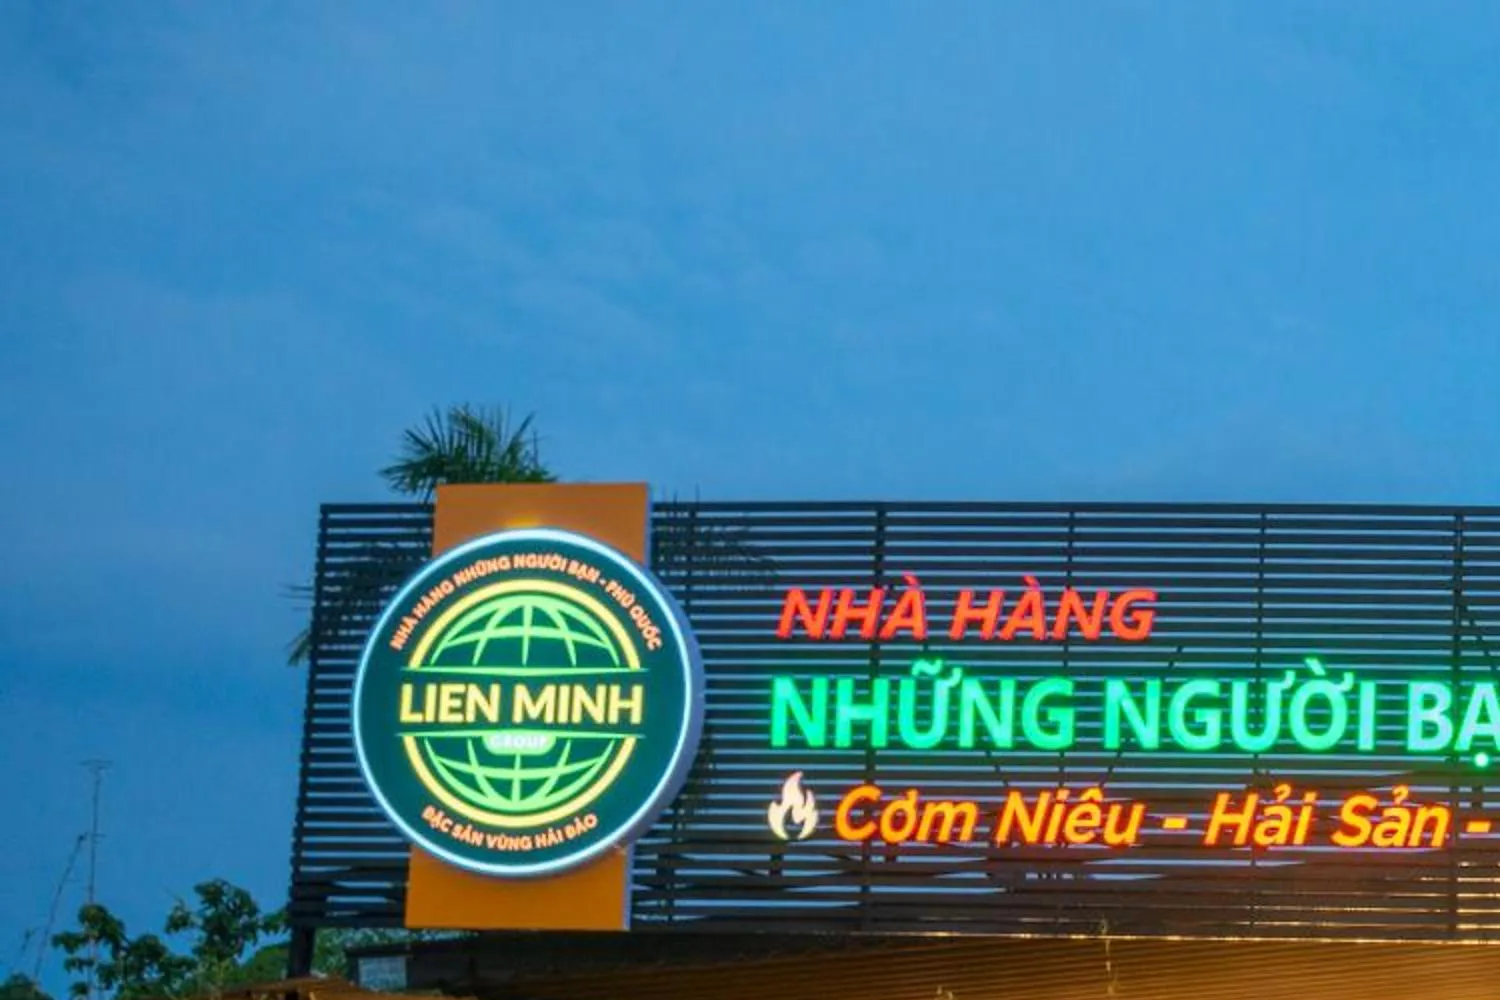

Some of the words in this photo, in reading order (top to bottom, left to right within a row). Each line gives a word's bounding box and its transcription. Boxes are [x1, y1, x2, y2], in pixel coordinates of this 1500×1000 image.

[775, 574, 927, 640] NHÀ
[948, 576, 1157, 641] HÀNG
[399, 683, 500, 724] LIEN
[512, 683, 643, 725] MINH
[769, 658, 1074, 749] NHỮNG
[1103, 658, 1376, 751] NGƯỜI
[834, 784, 978, 844] Cơm
[995, 787, 1143, 844] Niêu
[1162, 816, 1187, 829] -
[1205, 784, 1314, 846] Hải
[1331, 784, 1449, 848] Sản
[1466, 820, 1492, 832] -
